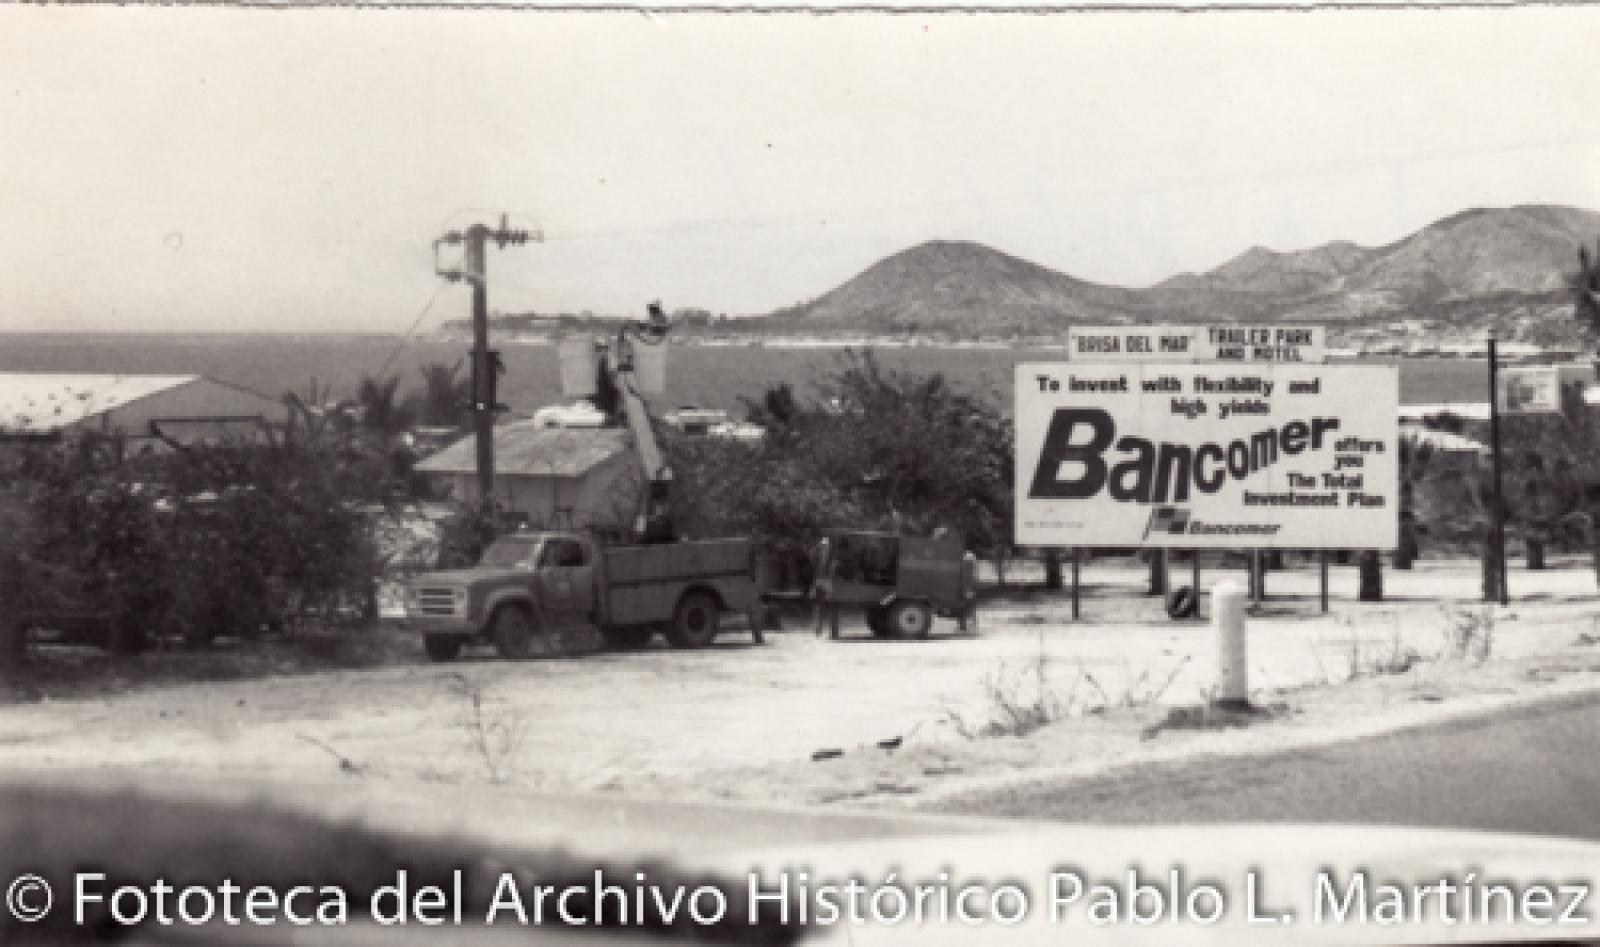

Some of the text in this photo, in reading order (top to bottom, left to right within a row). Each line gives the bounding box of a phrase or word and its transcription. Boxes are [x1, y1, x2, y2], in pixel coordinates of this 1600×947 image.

[1126, 335, 1152, 352] DEL
[1209, 327, 1312, 345] TRAILER PARK
[1216, 347, 1302, 361] AND MOTEL
[1036, 375, 1320, 397] To invest with flexibility and
[1171, 399, 1270, 418] high yields
[1334, 437, 1385, 452] offers
[1027, 408, 1340, 502] Bancomer
[1334, 454, 1364, 470] you
[1287, 473, 1364, 488] The Total
[1243, 490, 1386, 506] Investment Plan
[1189, 520, 1282, 535] Bancomer
